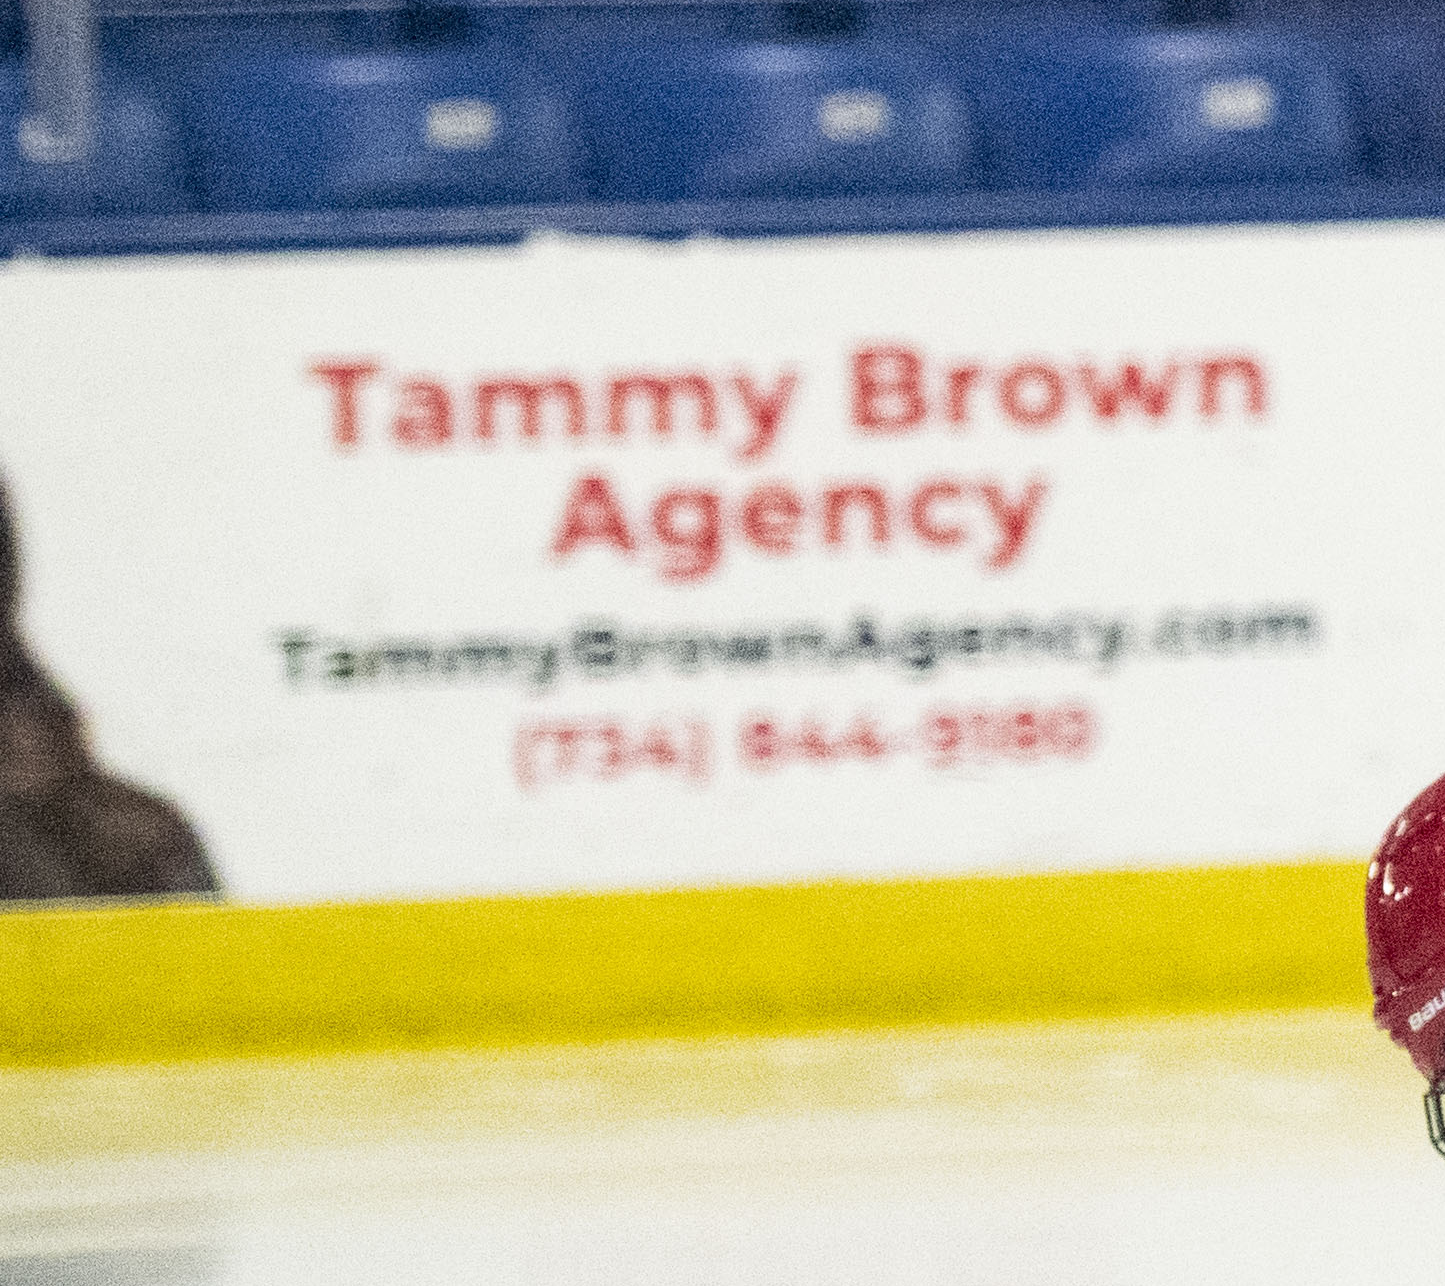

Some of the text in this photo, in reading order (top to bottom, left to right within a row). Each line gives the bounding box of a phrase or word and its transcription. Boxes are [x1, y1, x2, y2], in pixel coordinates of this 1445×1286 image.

[308, 341, 1270, 462] Tammy Brown
[550, 470, 1048, 584] Agency
[276, 606, 1320, 686] TammyBrownAgency.com
